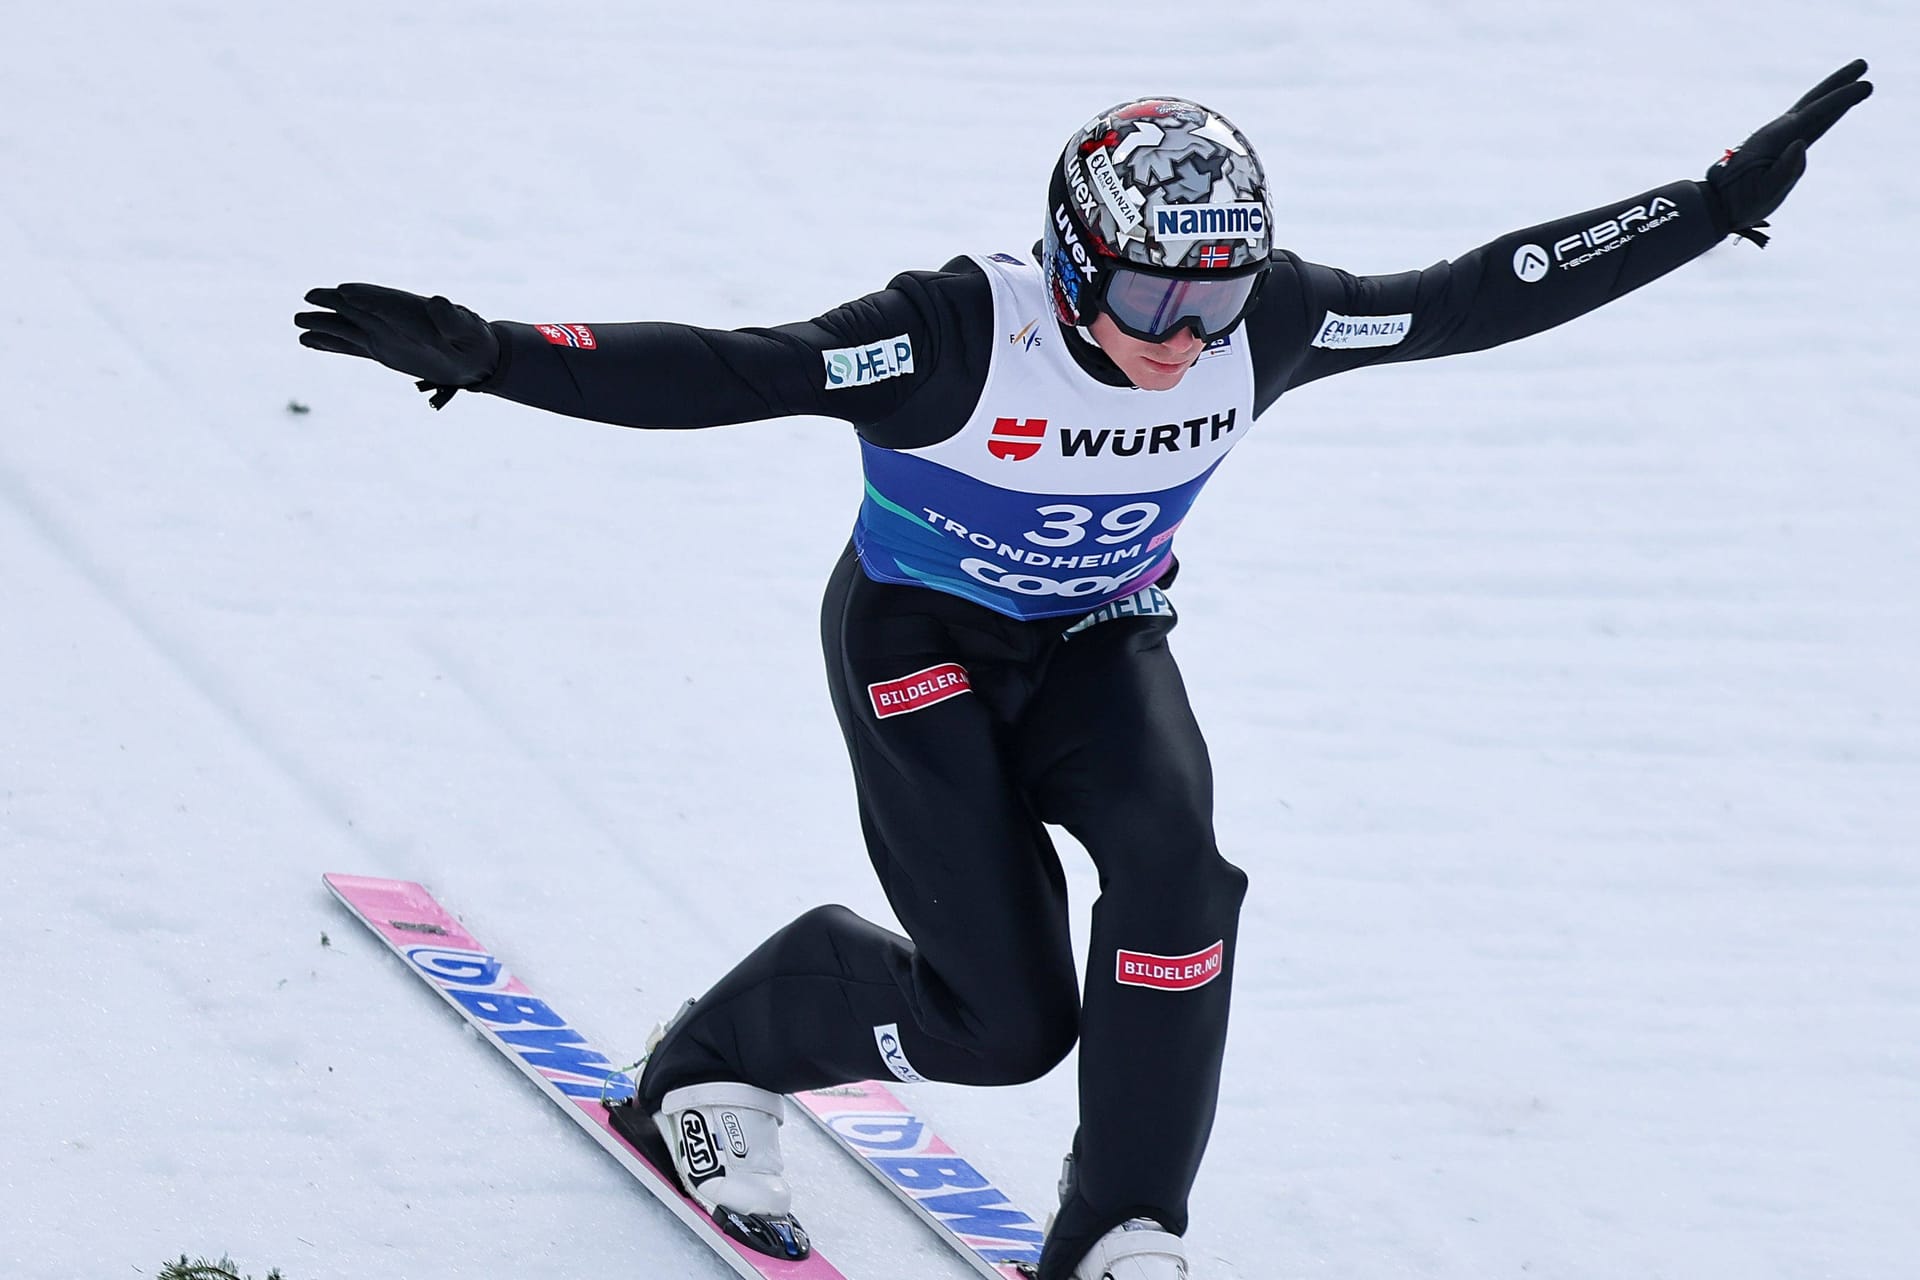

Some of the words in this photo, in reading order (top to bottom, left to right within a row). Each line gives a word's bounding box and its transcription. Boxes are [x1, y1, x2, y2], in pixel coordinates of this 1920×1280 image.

[1067, 155, 1098, 219] uvex
[1101, 170, 1136, 224] ADVANZIA
[1055, 203, 1099, 284] uvex
[1157, 207, 1263, 235] Nammo
[1554, 196, 1677, 261] FIBRA
[1559, 234, 1636, 270] TECHNICAL
[1637, 211, 1680, 233] WEAR
[573, 325, 593, 346] NOR
[1335, 322, 1405, 337] ADVANZIA
[856, 342, 911, 382] HELP
[1060, 408, 1237, 457] WÜRTH
[922, 507, 1143, 569] TRONDHEIM
[1023, 502, 1161, 547] 39
[1124, 953, 1219, 980] BILDELER.NO
[724, 1114, 743, 1151] EAGLE
